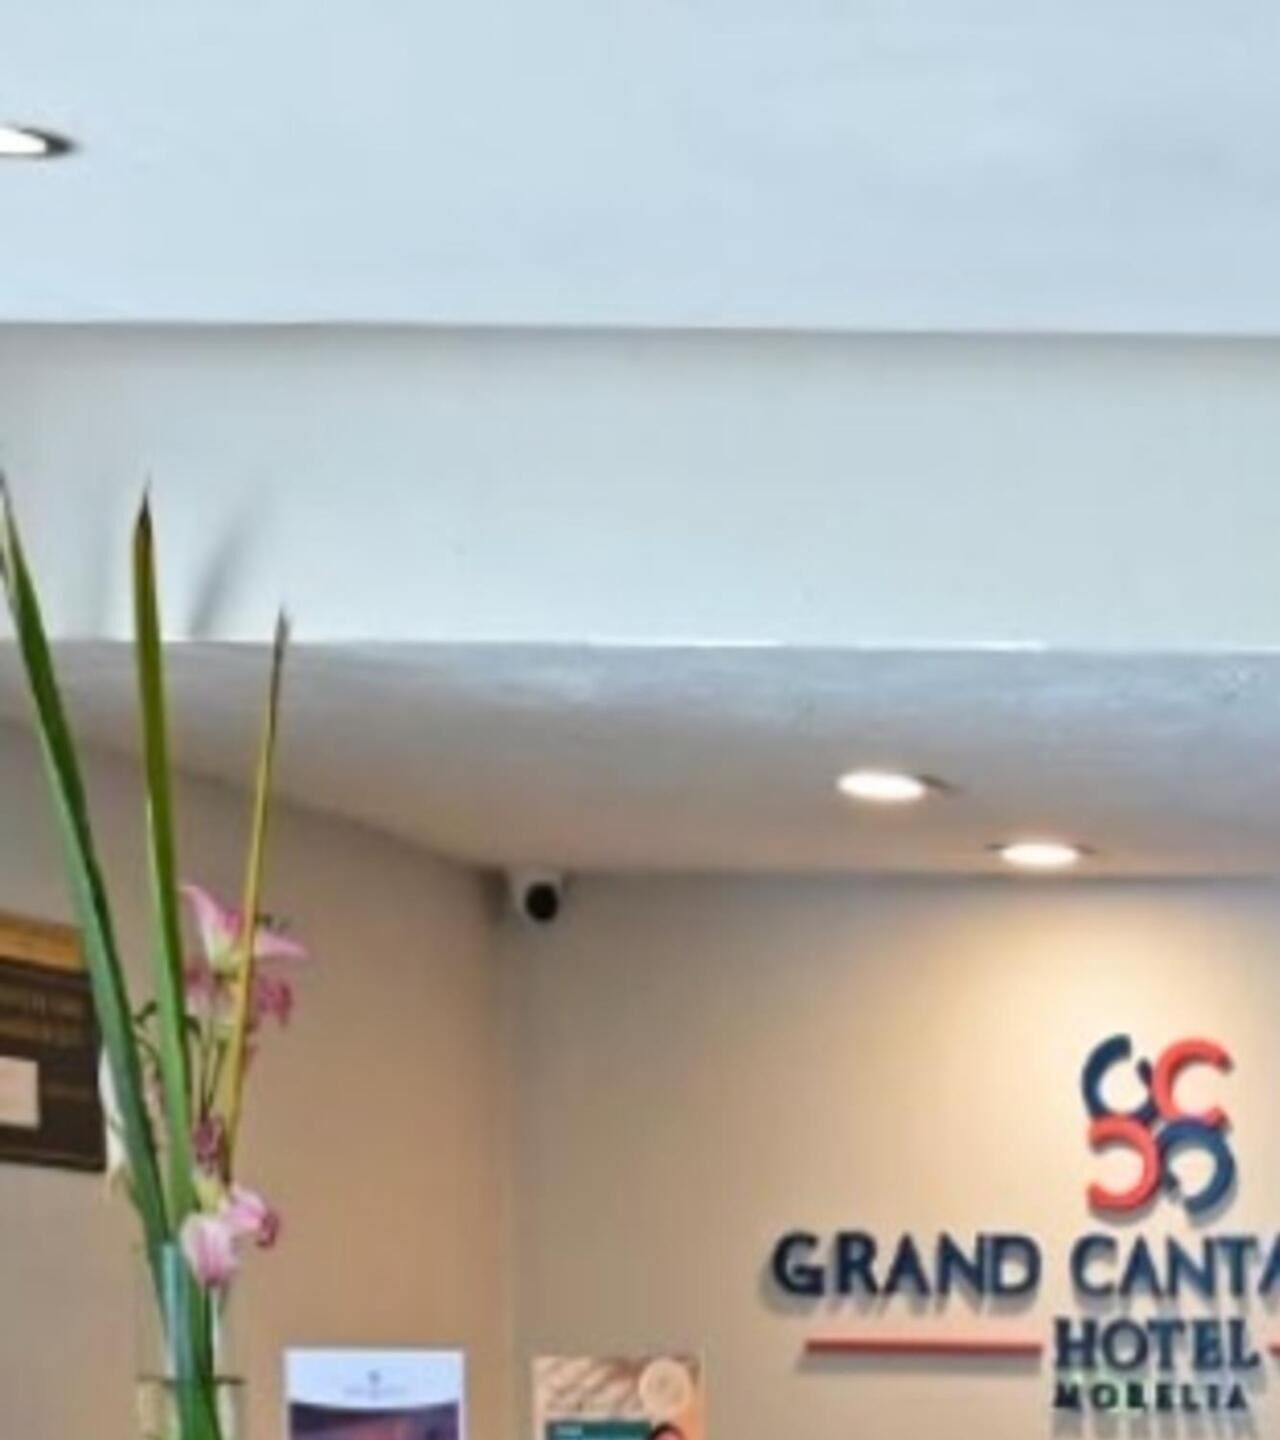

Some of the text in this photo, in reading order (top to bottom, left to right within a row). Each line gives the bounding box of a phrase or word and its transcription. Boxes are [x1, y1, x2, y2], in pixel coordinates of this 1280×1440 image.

[772, 1231, 1042, 1298] GRAND
[1053, 1316, 1260, 1373] HOTEL
[1052, 1382, 1250, 1411] MORELIA
